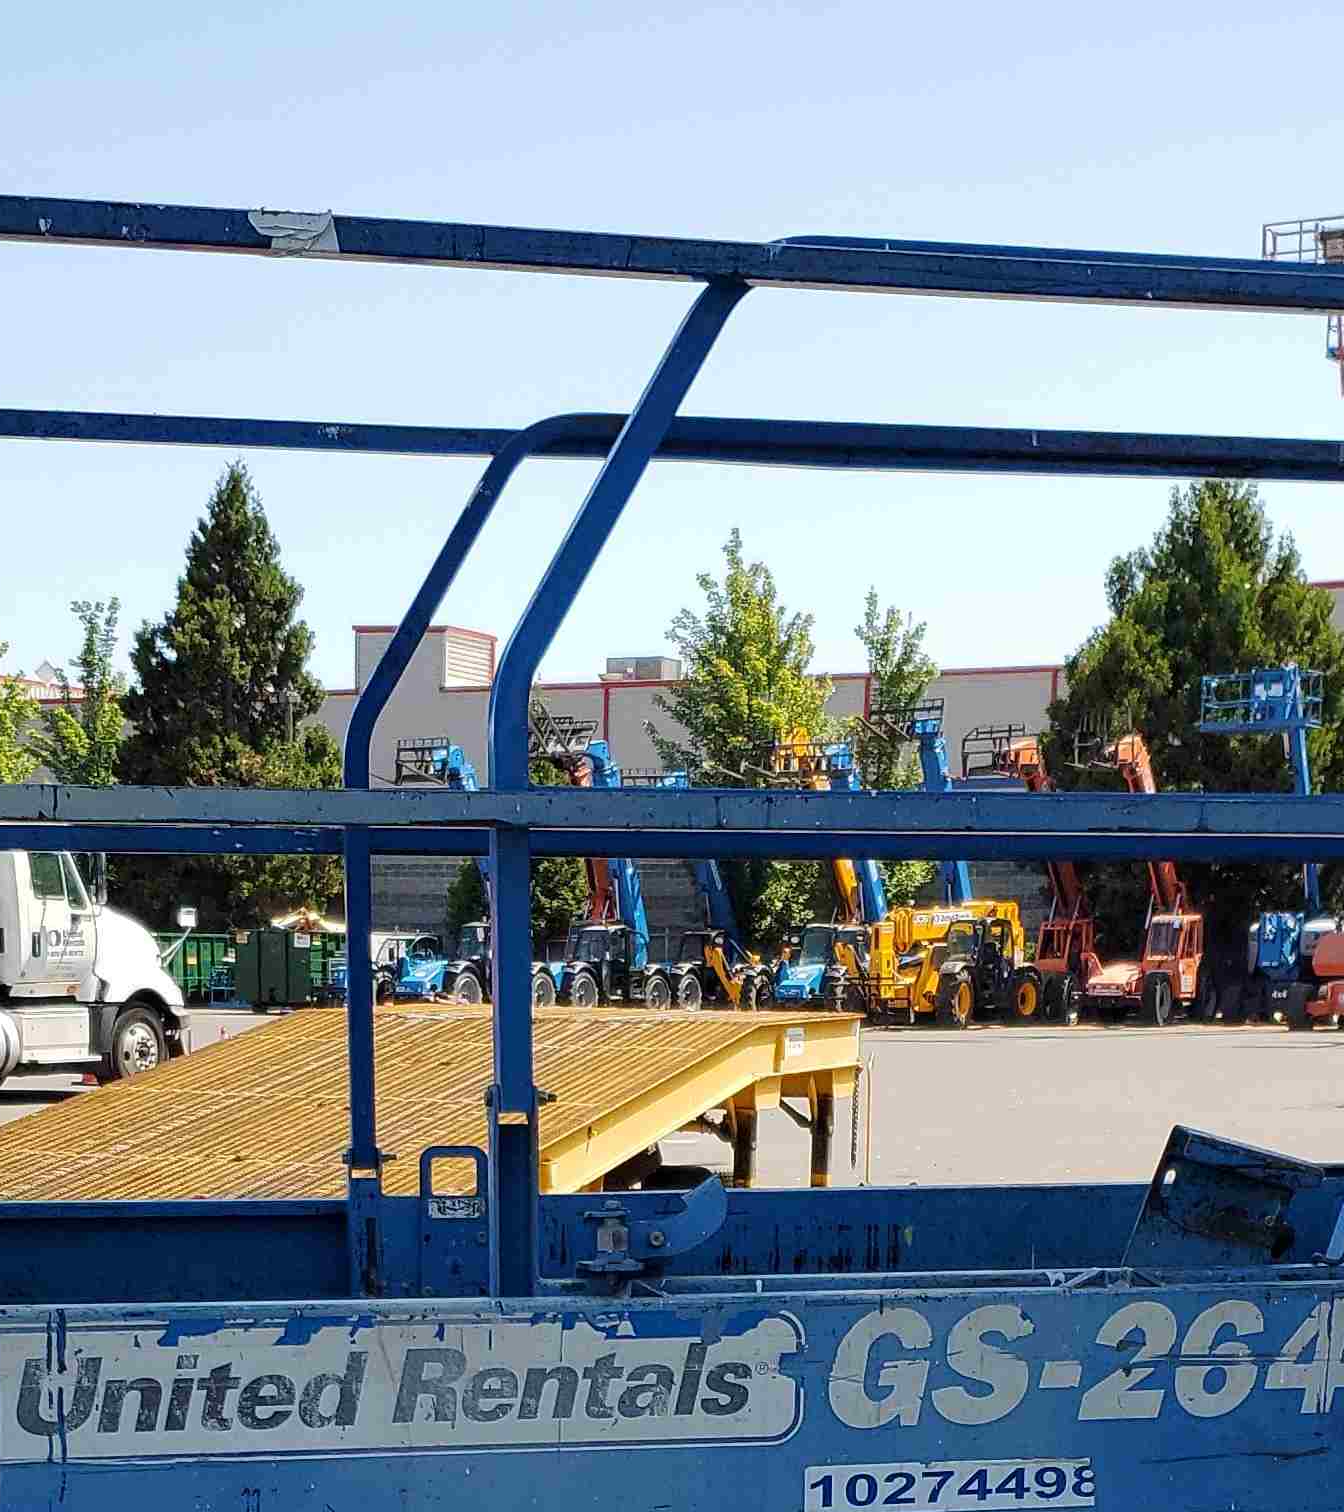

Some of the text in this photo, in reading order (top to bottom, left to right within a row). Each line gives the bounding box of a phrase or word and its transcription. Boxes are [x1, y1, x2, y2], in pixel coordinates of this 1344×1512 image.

[15, 1337, 754, 1438] United Rentals
[809, 1464, 1096, 1509] 10274498
